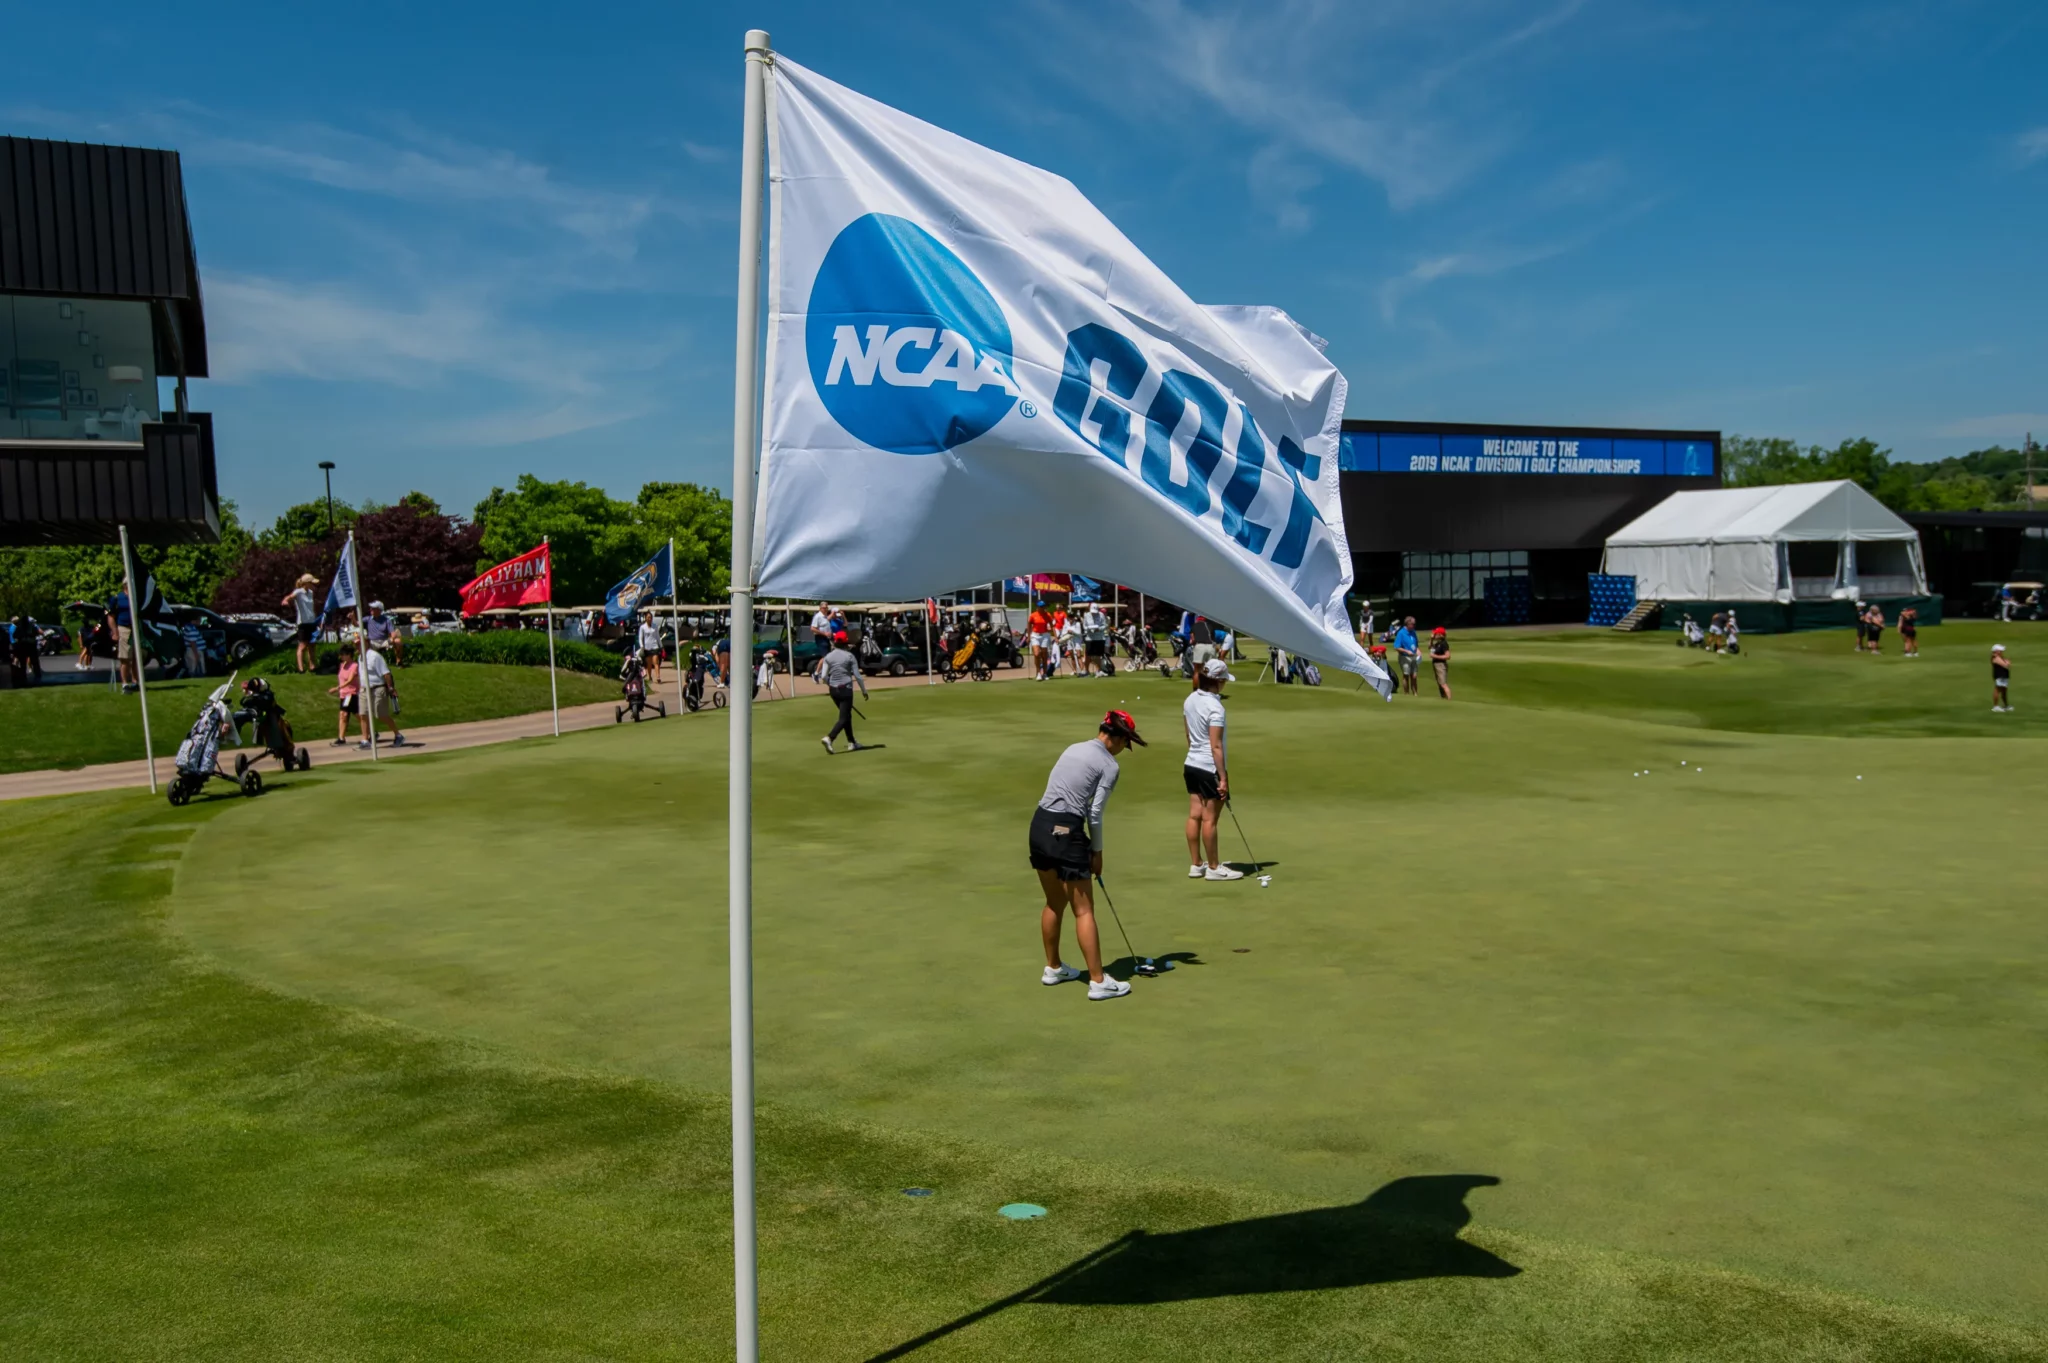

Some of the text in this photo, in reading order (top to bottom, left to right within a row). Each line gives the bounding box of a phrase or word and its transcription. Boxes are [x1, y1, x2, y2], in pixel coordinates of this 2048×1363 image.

[824, 325, 1021, 398] NCAA
[1053, 322, 1326, 570] GOLF
[1409, 455, 1438, 472] 2019
[1441, 455, 1471, 472] NCAA
[1475, 456, 1523, 473] DIVISION
[1530, 457, 1557, 473] GOLF
[1558, 458, 1641, 474] CHAMPIONSHIPS
[1483, 439, 1580, 457] WELCOME TO THE
